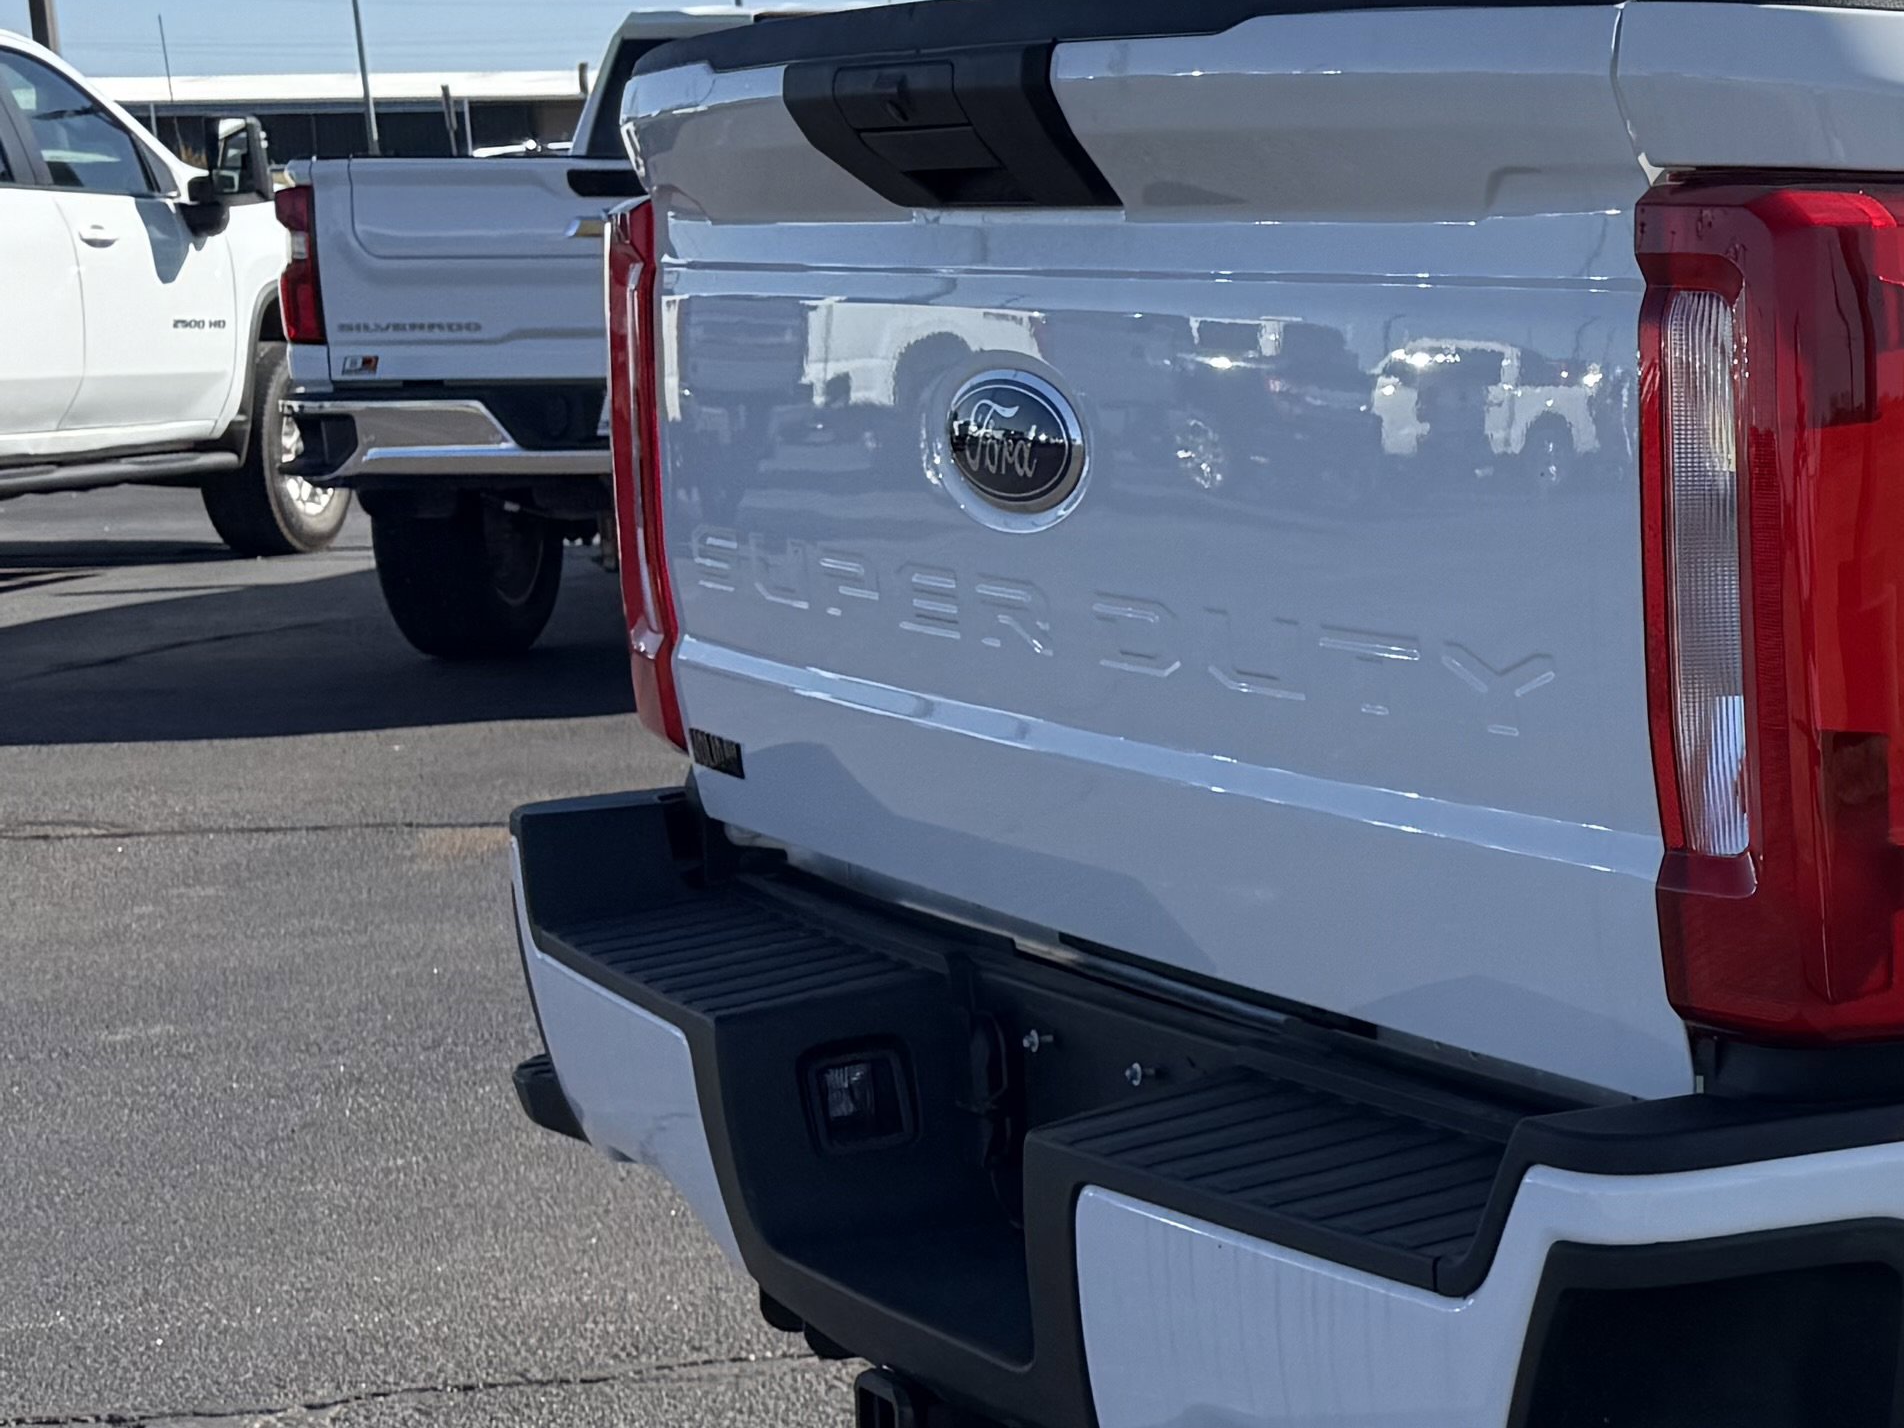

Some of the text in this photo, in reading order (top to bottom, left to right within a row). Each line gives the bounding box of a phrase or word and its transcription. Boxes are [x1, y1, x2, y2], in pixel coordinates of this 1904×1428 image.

[966, 399, 1037, 478] Ford
[691, 525, 1554, 736] SUPER DUTY
